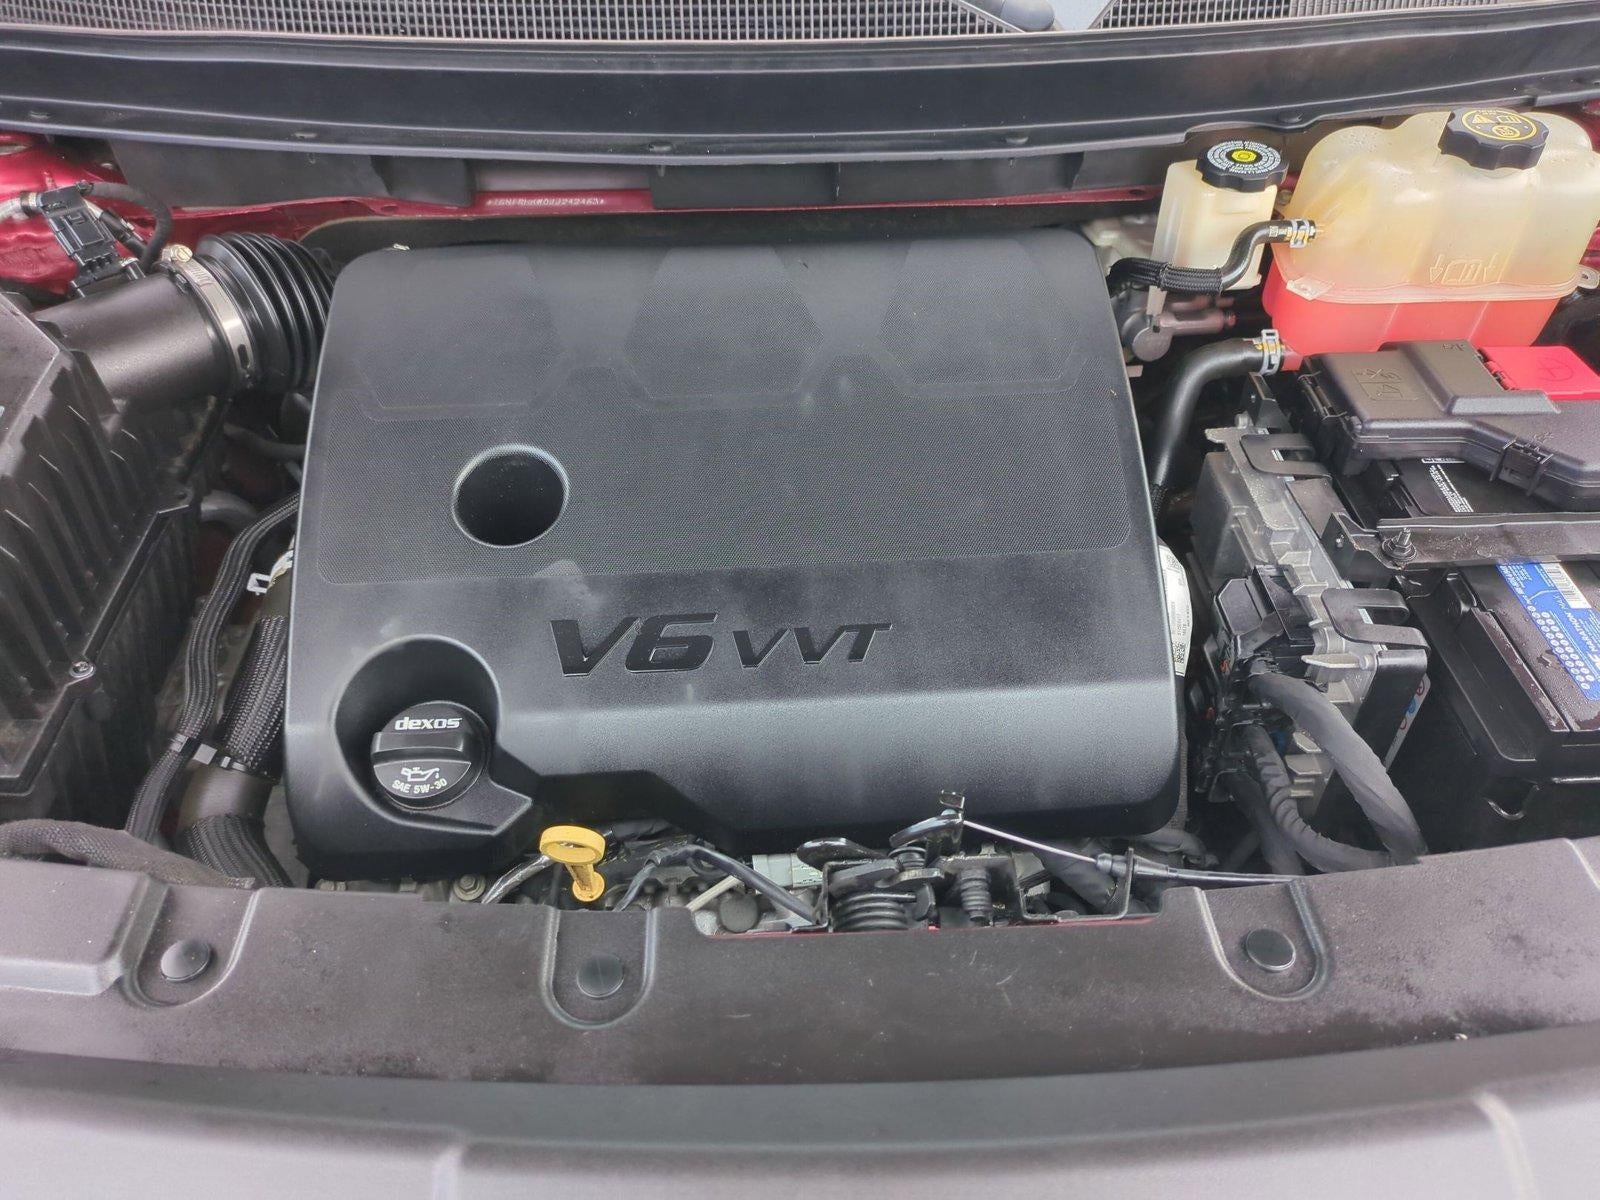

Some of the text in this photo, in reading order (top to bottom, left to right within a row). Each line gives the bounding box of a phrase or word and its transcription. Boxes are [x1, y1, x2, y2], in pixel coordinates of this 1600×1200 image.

[550, 612, 893, 677] V6 VVT
[394, 716, 463, 731] dexos
[392, 778, 448, 794] SAE 5W-30
